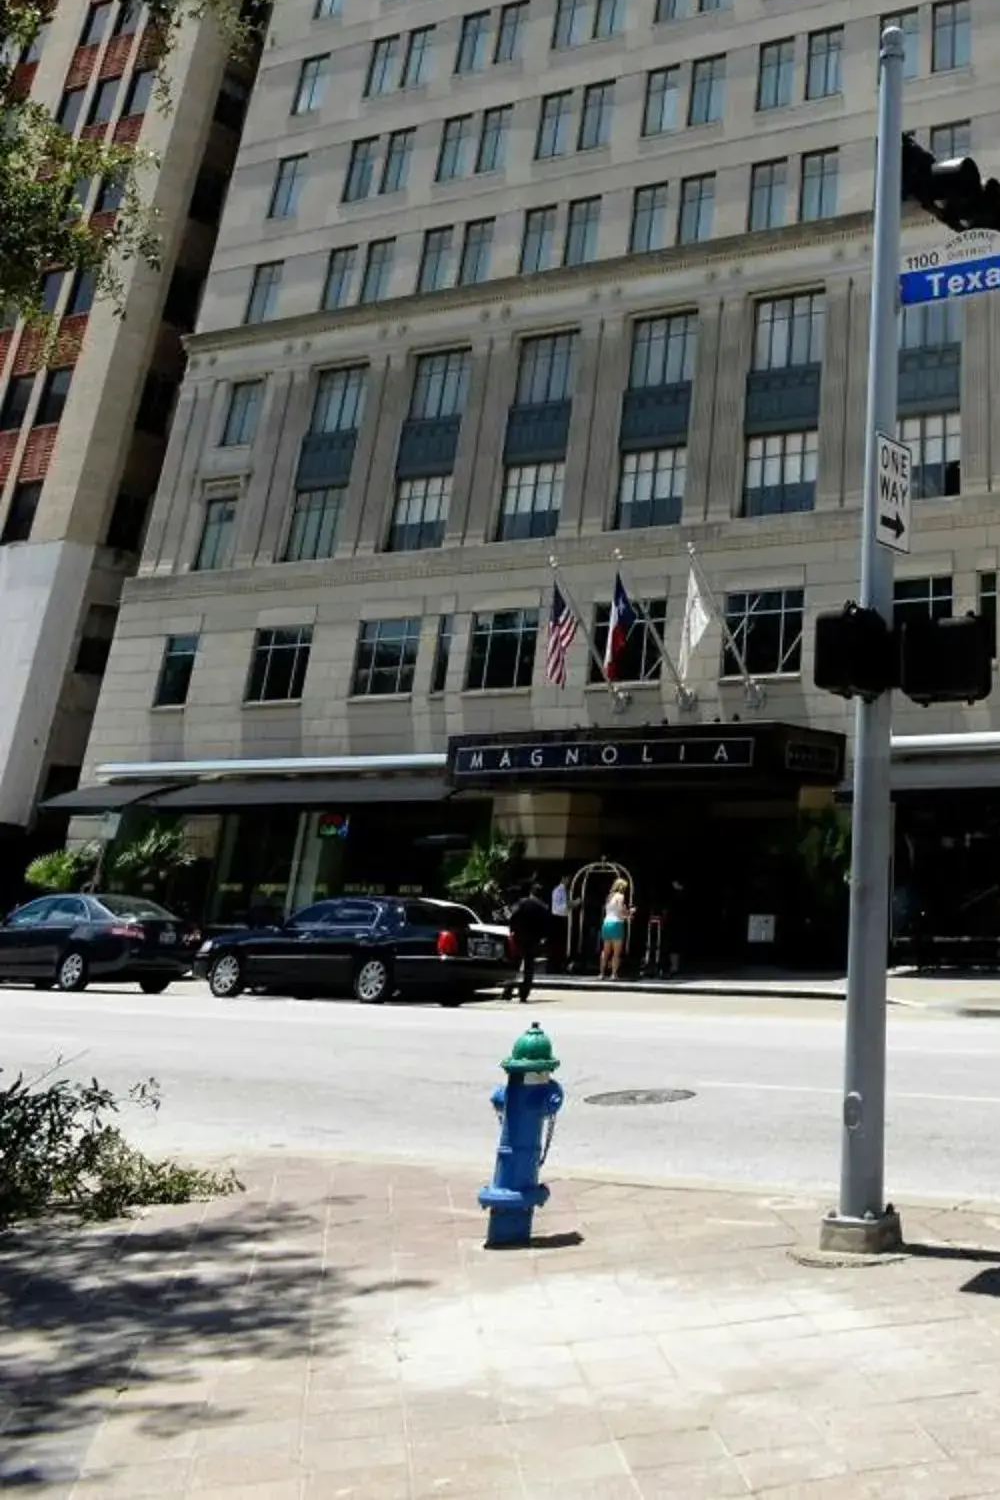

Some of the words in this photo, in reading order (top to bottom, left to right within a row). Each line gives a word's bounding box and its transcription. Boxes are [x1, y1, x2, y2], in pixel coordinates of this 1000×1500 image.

[906, 251, 940, 269] 1100
[881, 445, 907, 479] ONE
[879, 476, 909, 507] WAY
[469, 743, 729, 770] MAGNOLIA
